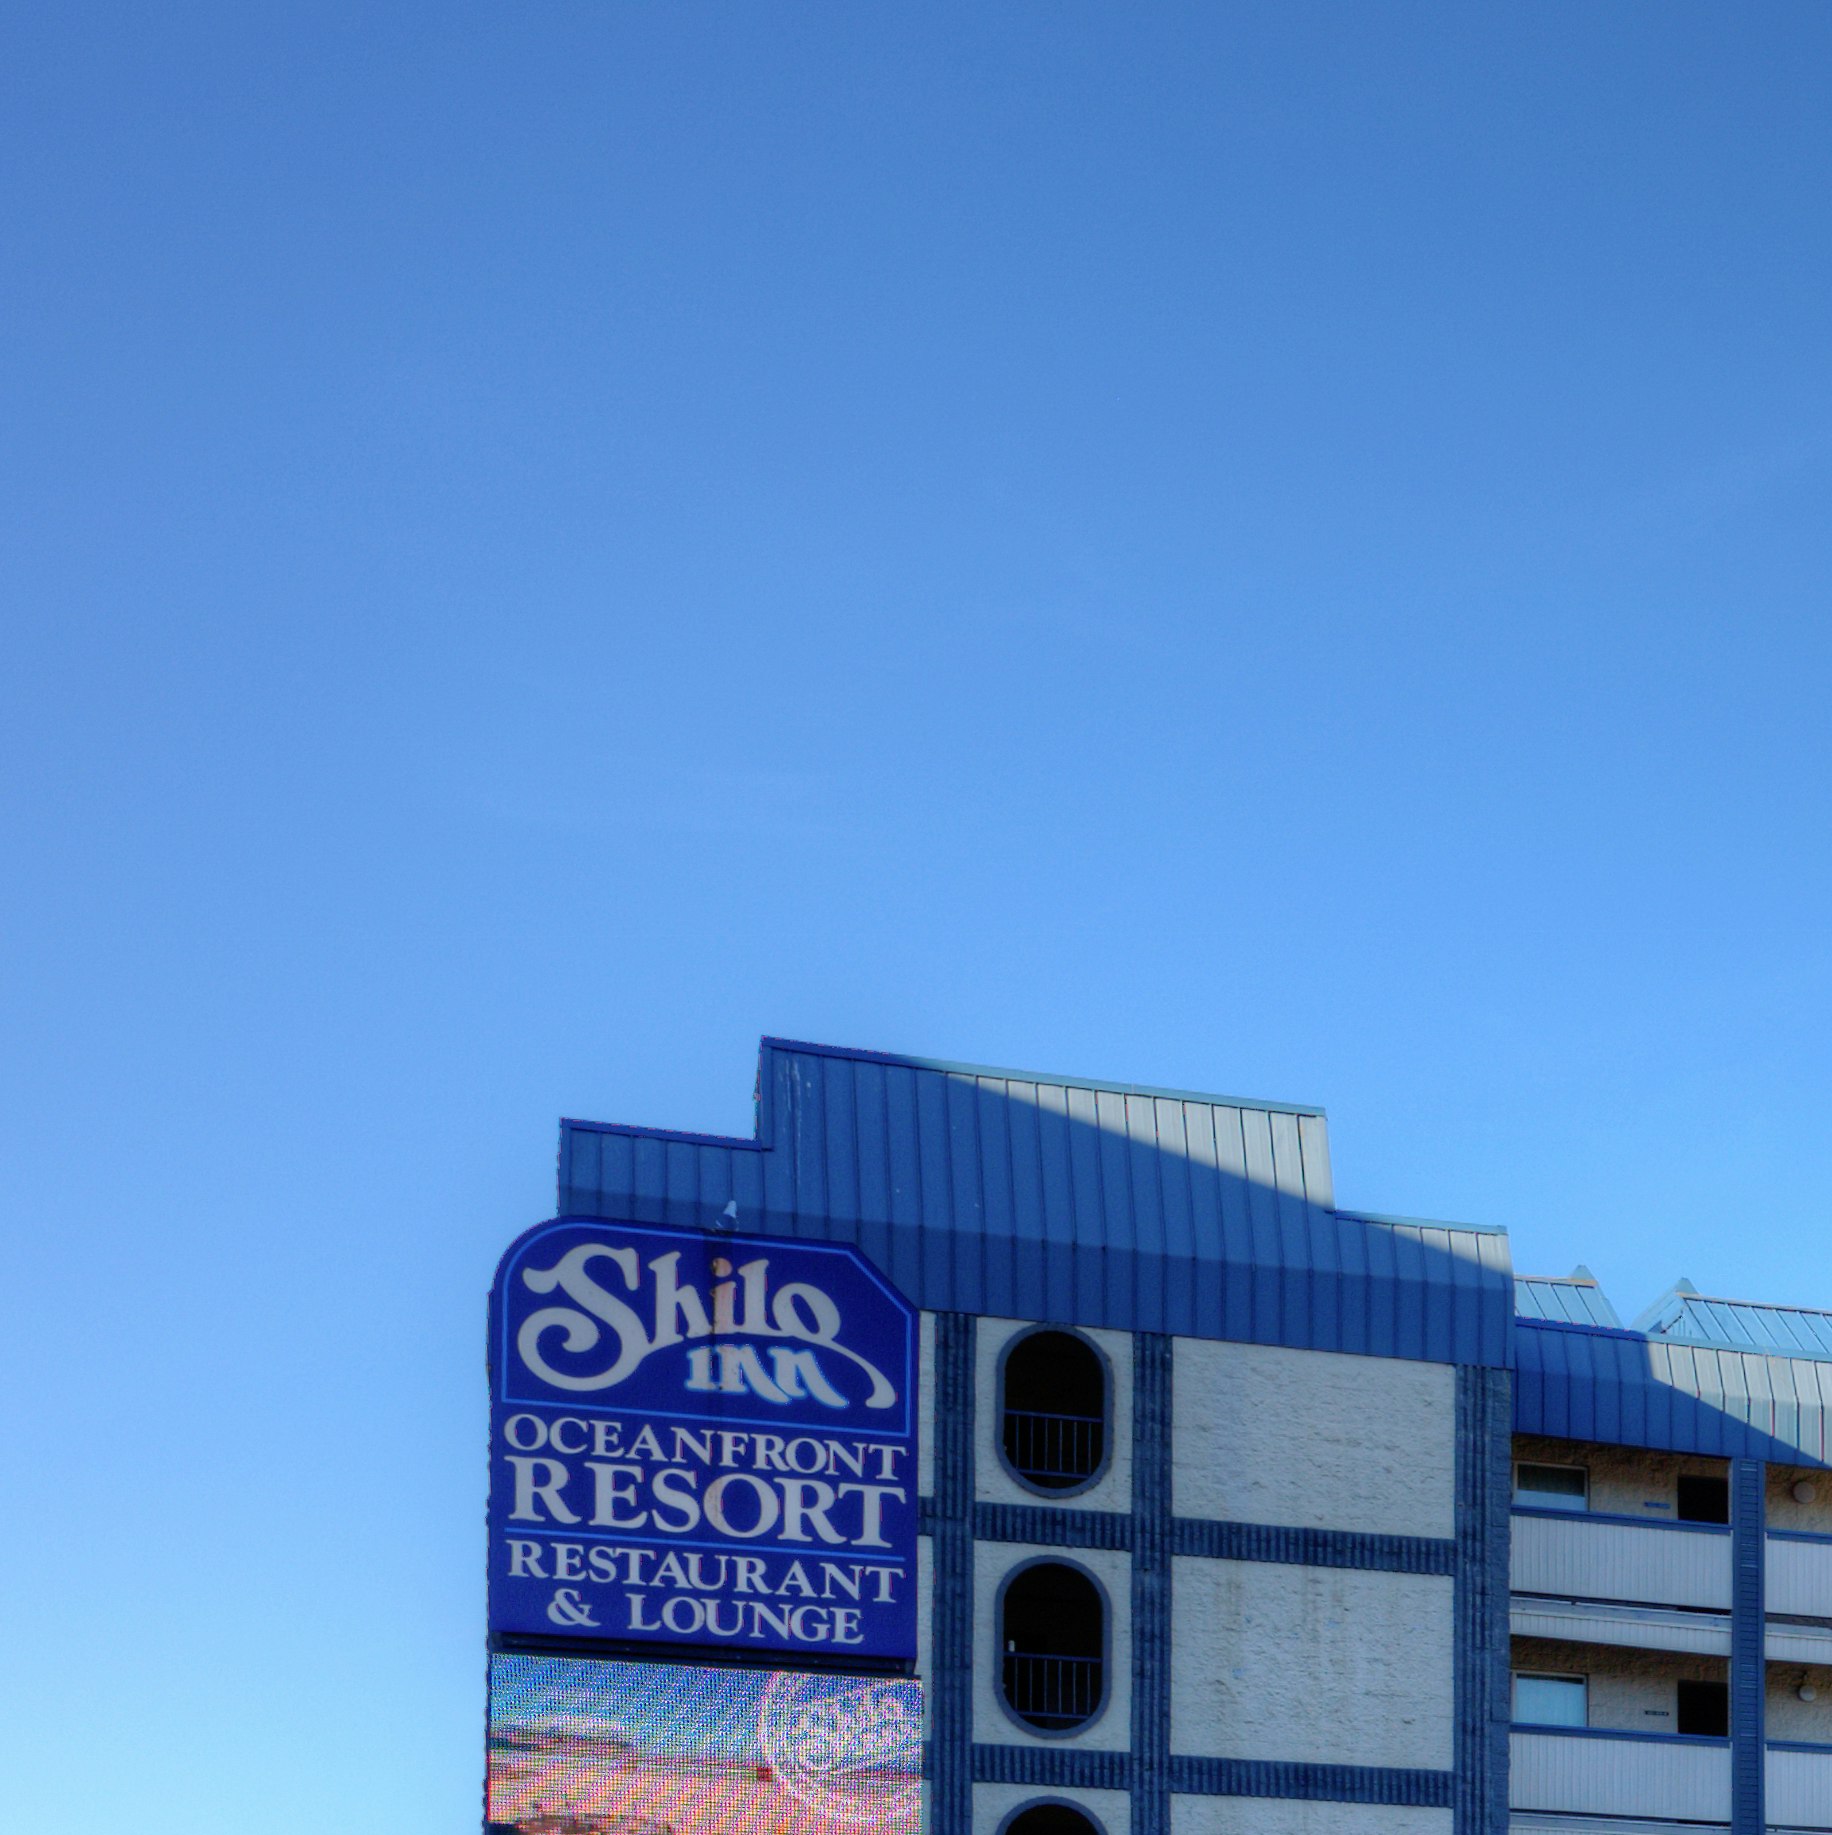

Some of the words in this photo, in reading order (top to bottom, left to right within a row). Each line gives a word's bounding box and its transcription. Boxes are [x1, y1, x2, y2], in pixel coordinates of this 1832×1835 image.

[517, 1243, 897, 1409] Shilo
[686, 1344, 848, 1408] INN
[504, 1413, 907, 1480] OCEANFRONT
[504, 1455, 907, 1548] RESORT
[505, 1539, 905, 1603] RESTAURANT
[547, 1588, 600, 1627] &
[627, 1593, 864, 1645] LOUNGE
